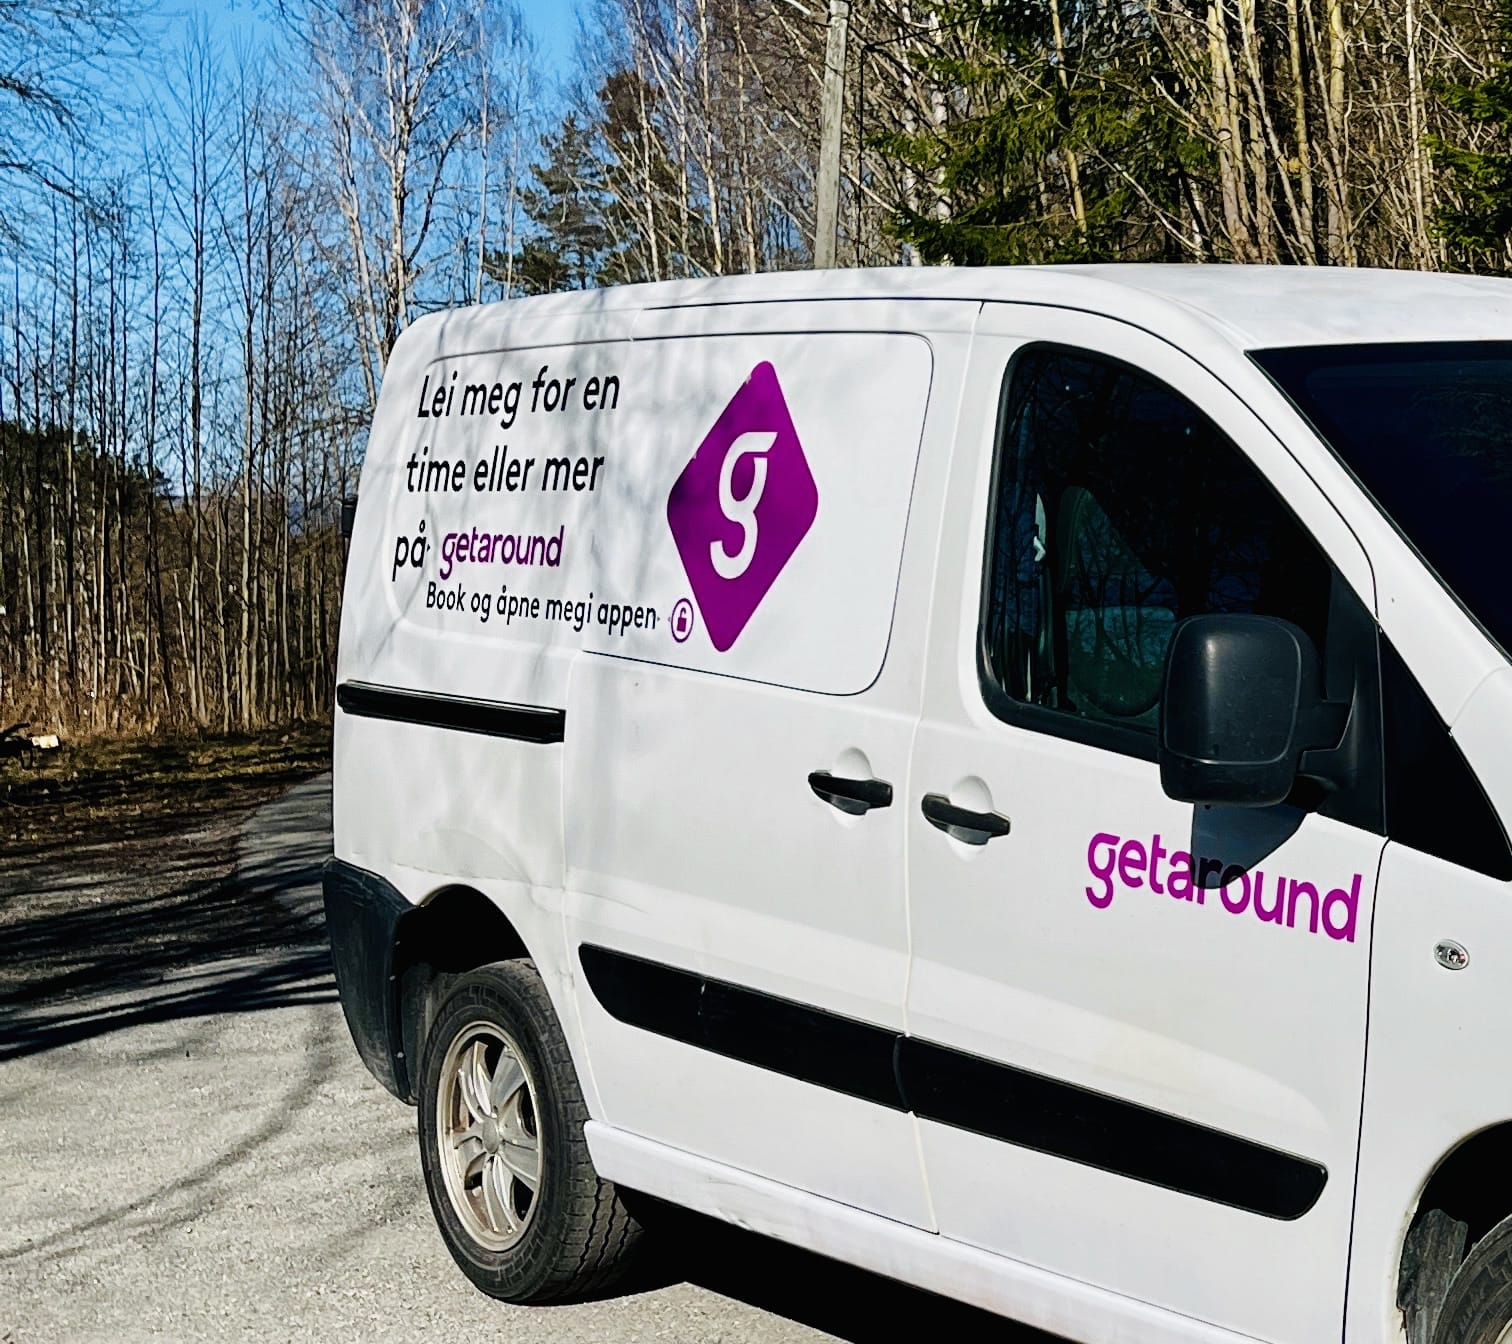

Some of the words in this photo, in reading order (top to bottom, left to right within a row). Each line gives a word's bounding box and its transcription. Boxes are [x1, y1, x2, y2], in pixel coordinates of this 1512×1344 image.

[417, 370, 457, 418] Lei
[460, 382, 522, 429] meg
[531, 365, 576, 412] for
[583, 375, 620, 410] en
[406, 446, 466, 492] time
[473, 445, 535, 492] eller
[541, 456, 605, 492] mer
[392, 519, 427, 582] på
[439, 525, 565, 580] getaround
[426, 581, 466, 611] Book
[471, 592, 491, 623] og
[497, 585, 540, 625] åpne
[597, 603, 656, 636] appen
[1085, 832, 1362, 943] getaround
